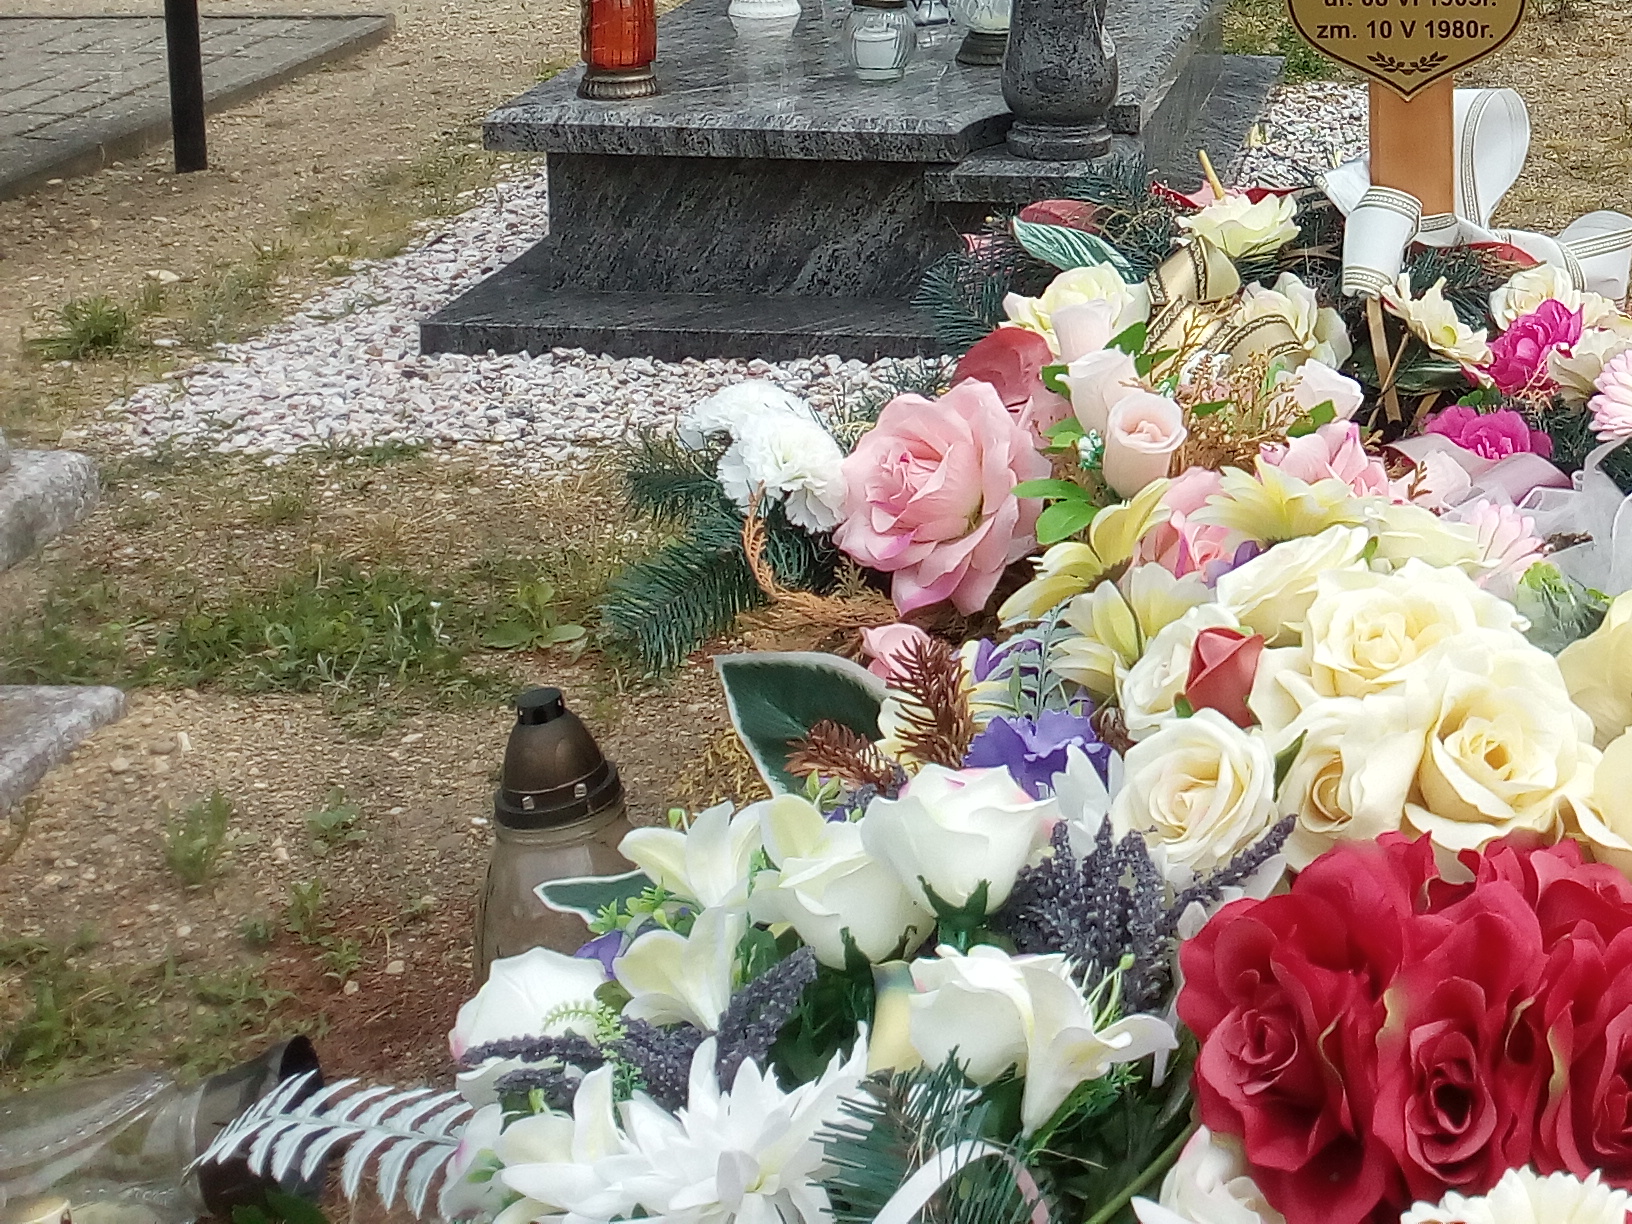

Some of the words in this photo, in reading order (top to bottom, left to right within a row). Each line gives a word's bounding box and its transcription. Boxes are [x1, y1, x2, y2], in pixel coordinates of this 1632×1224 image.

[1316, 24, 1357, 40] zm.
[1366, 19, 1393, 39] 10
[1399, 20, 1417, 39] V
[1424, 19, 1495, 39] 1980r.
